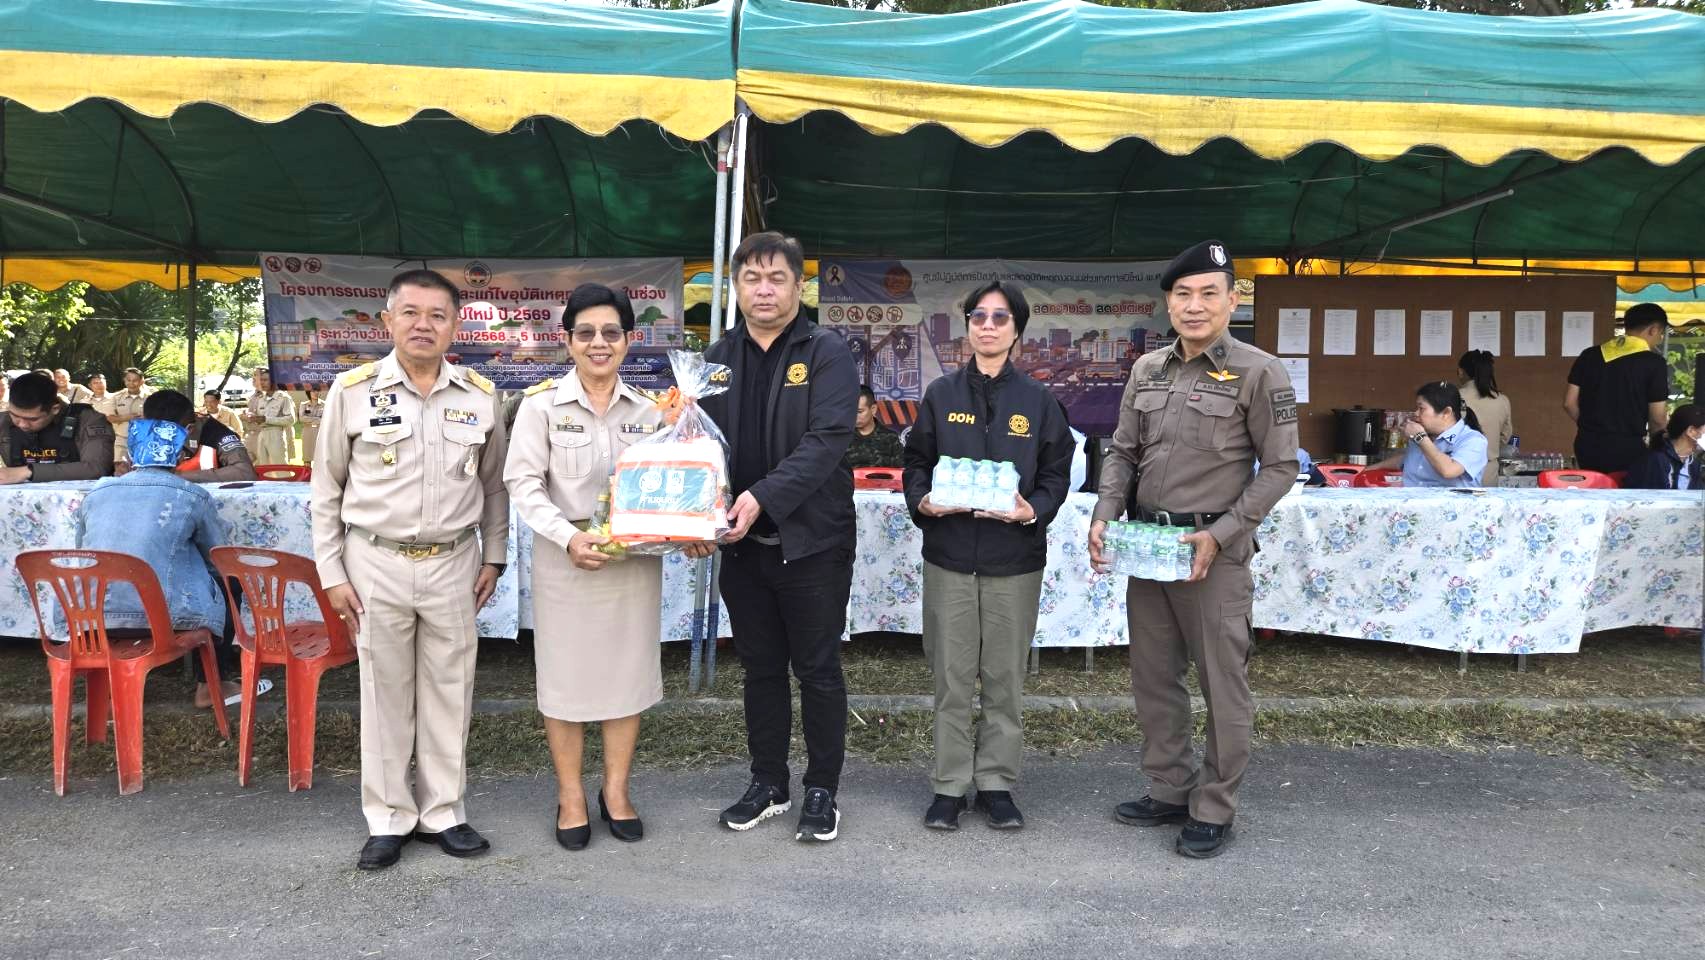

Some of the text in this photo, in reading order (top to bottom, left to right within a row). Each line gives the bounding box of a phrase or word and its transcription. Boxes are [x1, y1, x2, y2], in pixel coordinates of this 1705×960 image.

[280, 282, 388, 298] โครงการรณรง
[623, 285, 667, 300] ในช่วง
[513, 308, 551, 321] 2569
[320, 328, 393, 340] ระหว่างวันท
[473, 331, 506, 342] 2568
[520, 332, 529, 342] 5
[532, 332, 565, 341] มกรา
[948, 413, 975, 425] DOH
